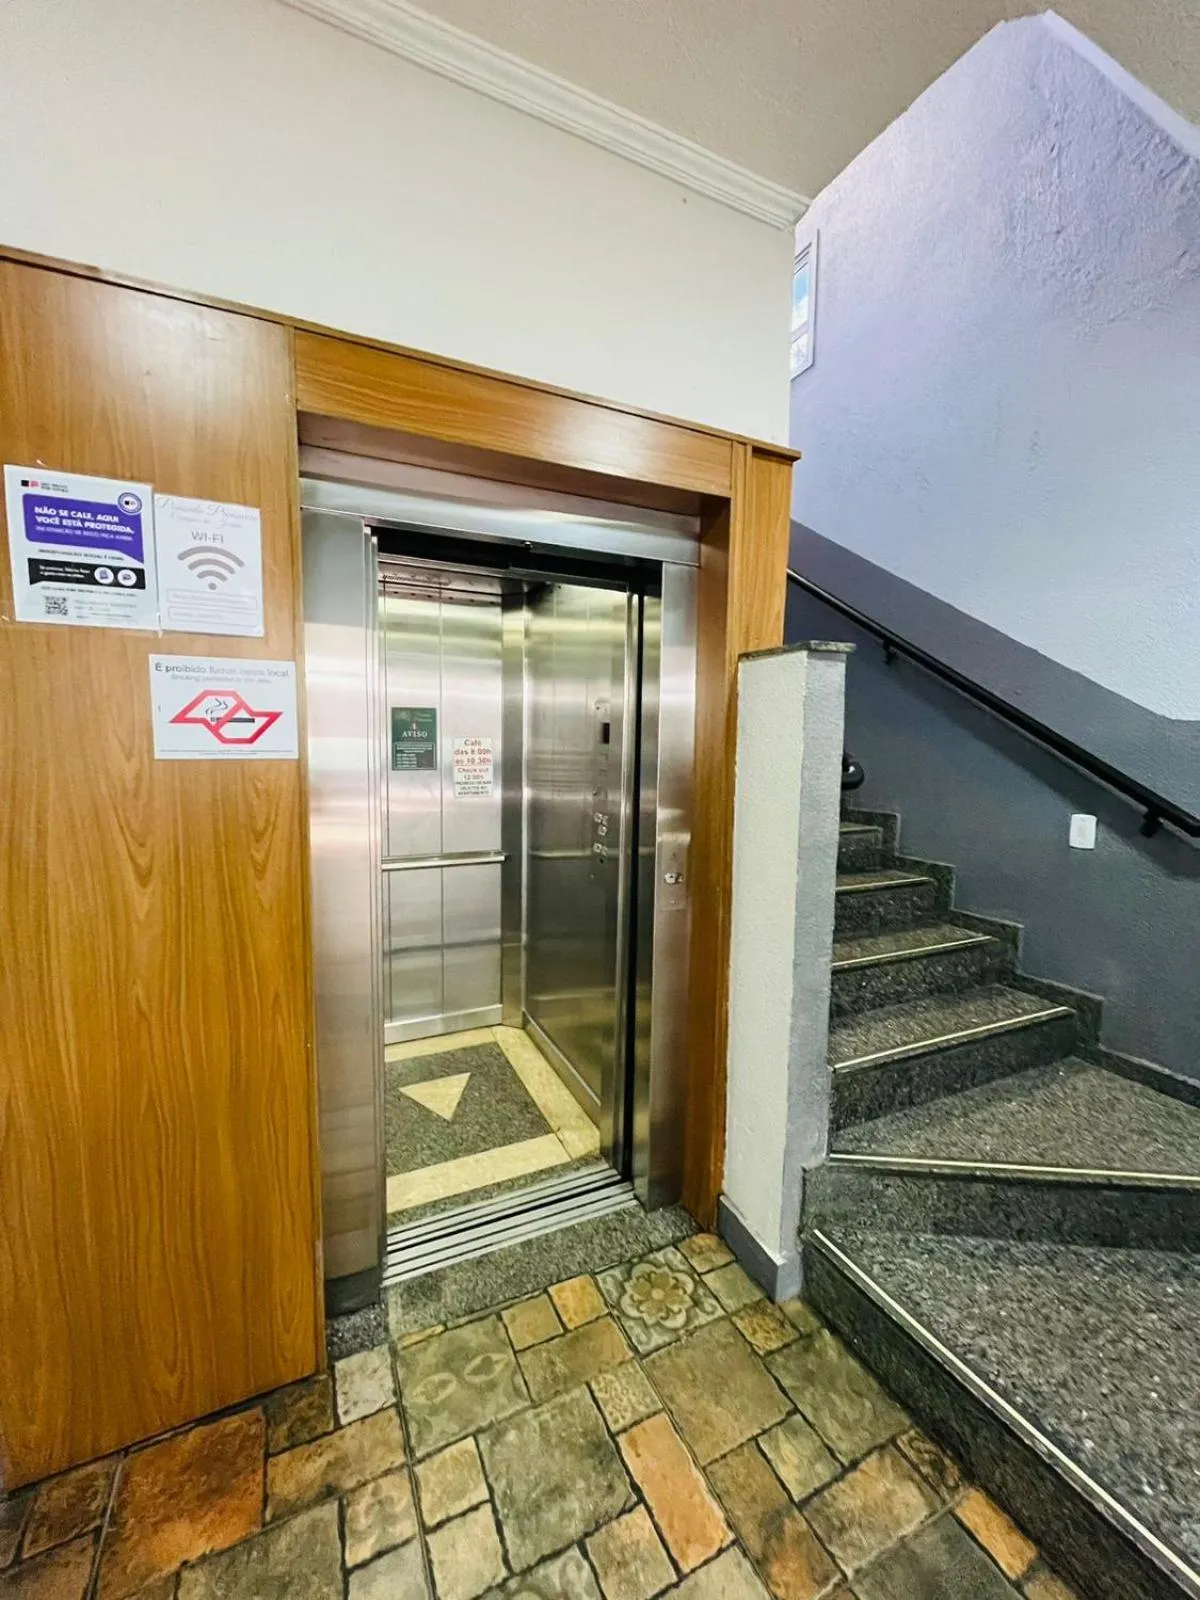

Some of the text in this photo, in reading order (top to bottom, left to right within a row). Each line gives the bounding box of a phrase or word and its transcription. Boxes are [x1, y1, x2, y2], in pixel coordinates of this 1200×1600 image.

[34, 506, 57, 515] NÃO
[59, 509, 69, 517] SE
[96, 513, 119, 523] AQUI
[36, 515, 60, 525] VOCÊ
[62, 518, 83, 528] ESTÁ
[154, 662, 163, 672] É
[165, 664, 207, 674] proibido
[266, 667, 289, 677] local
[401, 730, 428, 738] AVISO
